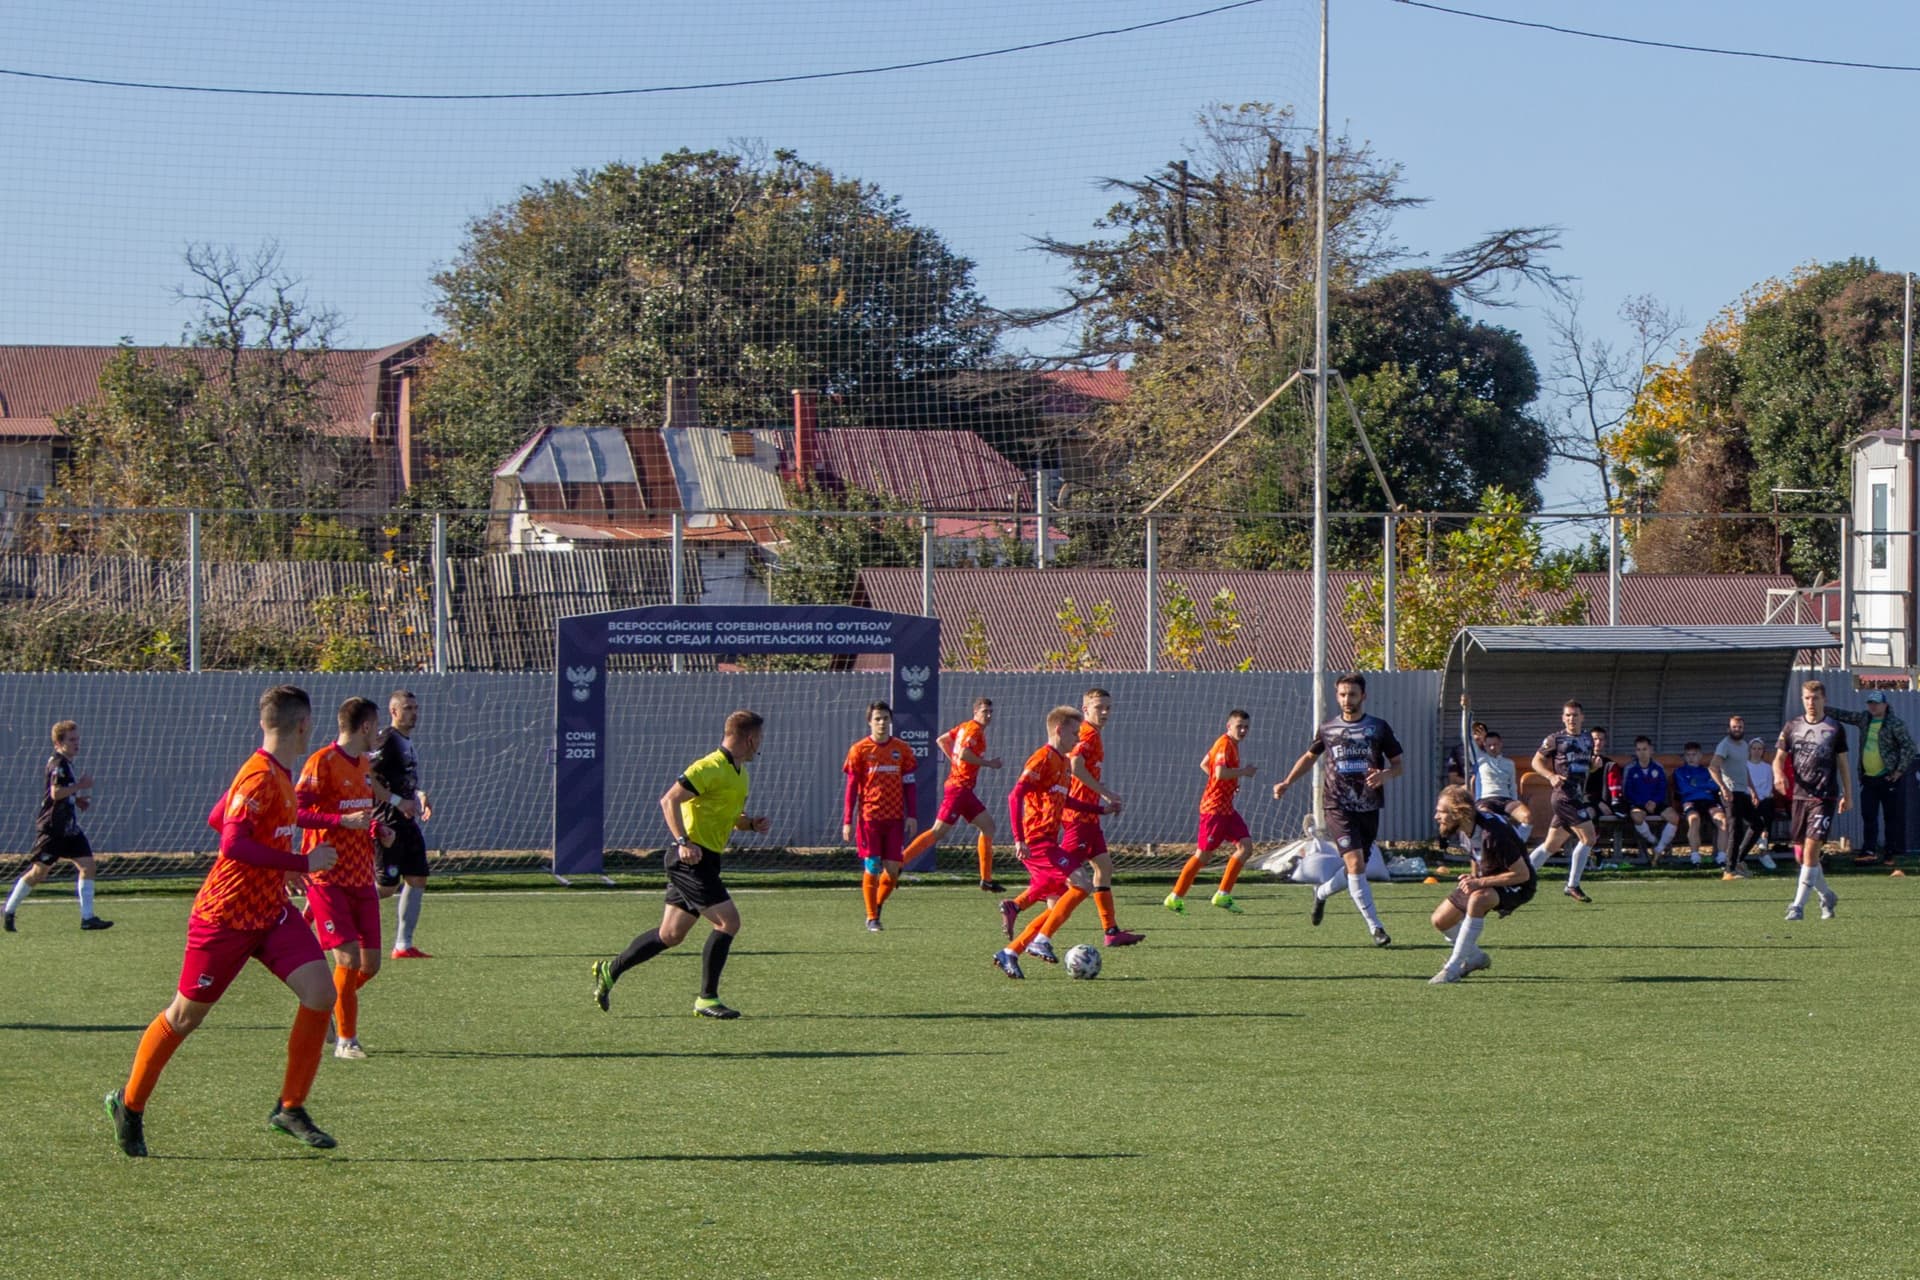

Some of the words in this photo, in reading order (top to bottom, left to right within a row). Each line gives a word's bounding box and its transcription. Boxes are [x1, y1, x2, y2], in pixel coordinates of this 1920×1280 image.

[608, 620, 713, 631] ВСЕРОССИЙСКИЕ
[715, 622, 813, 631] СОРЕВНОВАНИЯ
[816, 622, 833, 631] ПО
[836, 622, 892, 631] ФУТБОЛУ
[608, 634, 663, 645] «КУБОК
[666, 634, 711, 646] СРЕДИ
[714, 634, 824, 645] ЛЮБИТЕЛЬСКИХ
[827, 634, 892, 646] КОМАНД»
[565, 731, 596, 740] СОЧИ
[900, 731, 929, 740] СОЧИ
[565, 748, 596, 758] 2021
[911, 747, 929, 757] 21
[1813, 814, 1831, 829] 76
